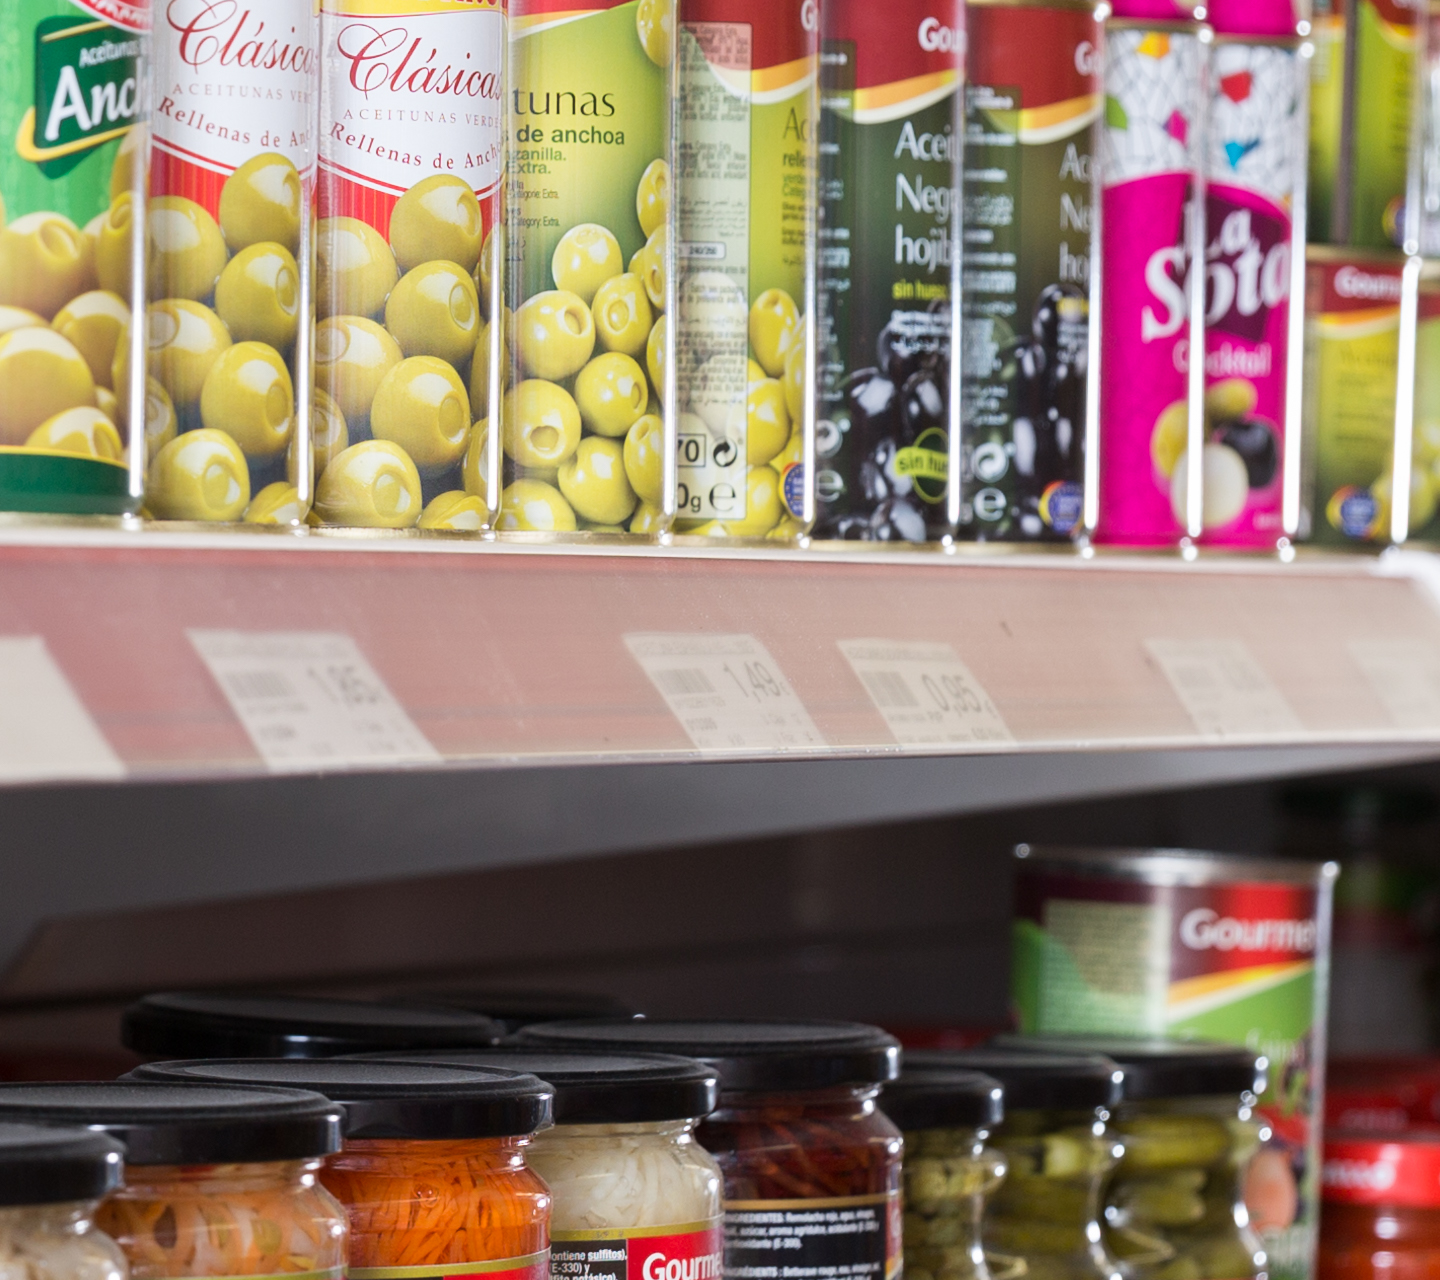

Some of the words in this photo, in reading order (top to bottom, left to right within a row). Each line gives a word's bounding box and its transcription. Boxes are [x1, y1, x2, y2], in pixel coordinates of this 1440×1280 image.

[172, 82, 283, 101] ACEITUNAS
[511, 87, 616, 118] tunas
[157, 96, 250, 145] Rellenas
[260, 131, 281, 149] de
[343, 108, 457, 125] ACEITUNAS
[328, 121, 422, 168] Rellenas
[432, 150, 455, 170] de
[516, 124, 544, 144] de
[551, 125, 625, 146] anchoa
[922, 673, 983, 718] 0,95
